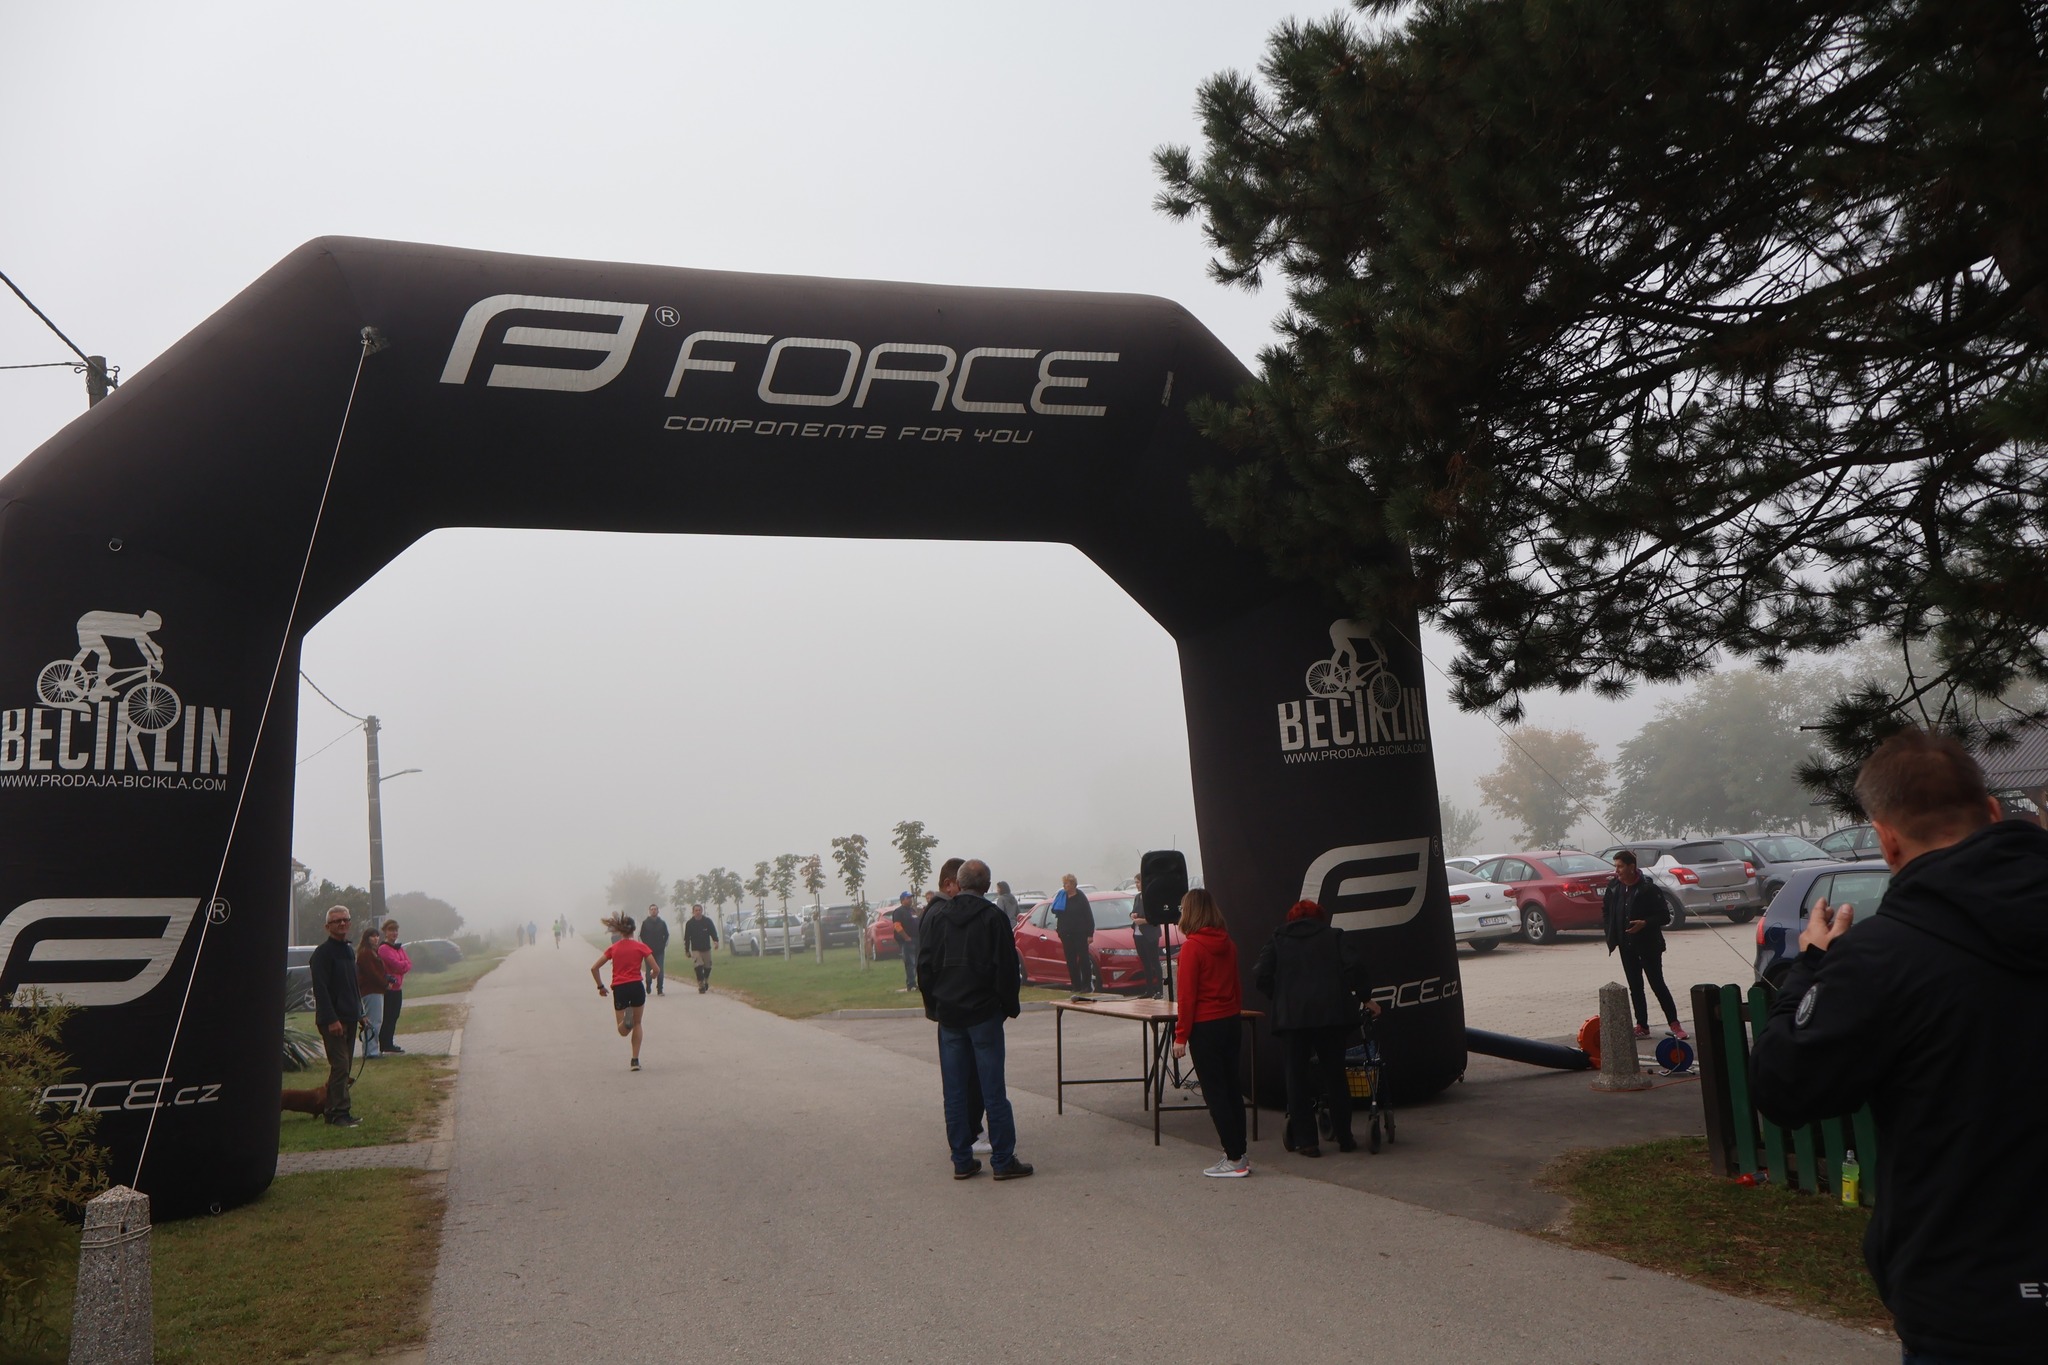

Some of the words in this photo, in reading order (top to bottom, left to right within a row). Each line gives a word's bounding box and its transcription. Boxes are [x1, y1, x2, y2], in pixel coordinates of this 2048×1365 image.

[664, 331, 1119, 416] FORCE
[664, 416, 887, 439] COMPONENTS
[898, 427, 963, 442] FOR
[974, 429, 1033, 443] YOU
[0, 701, 231, 775] BECIKLIN
[1278, 688, 1426, 751] BECIKLIN
[0, 774, 226, 791] WWW.PRODAJA-BICIKLA.COM
